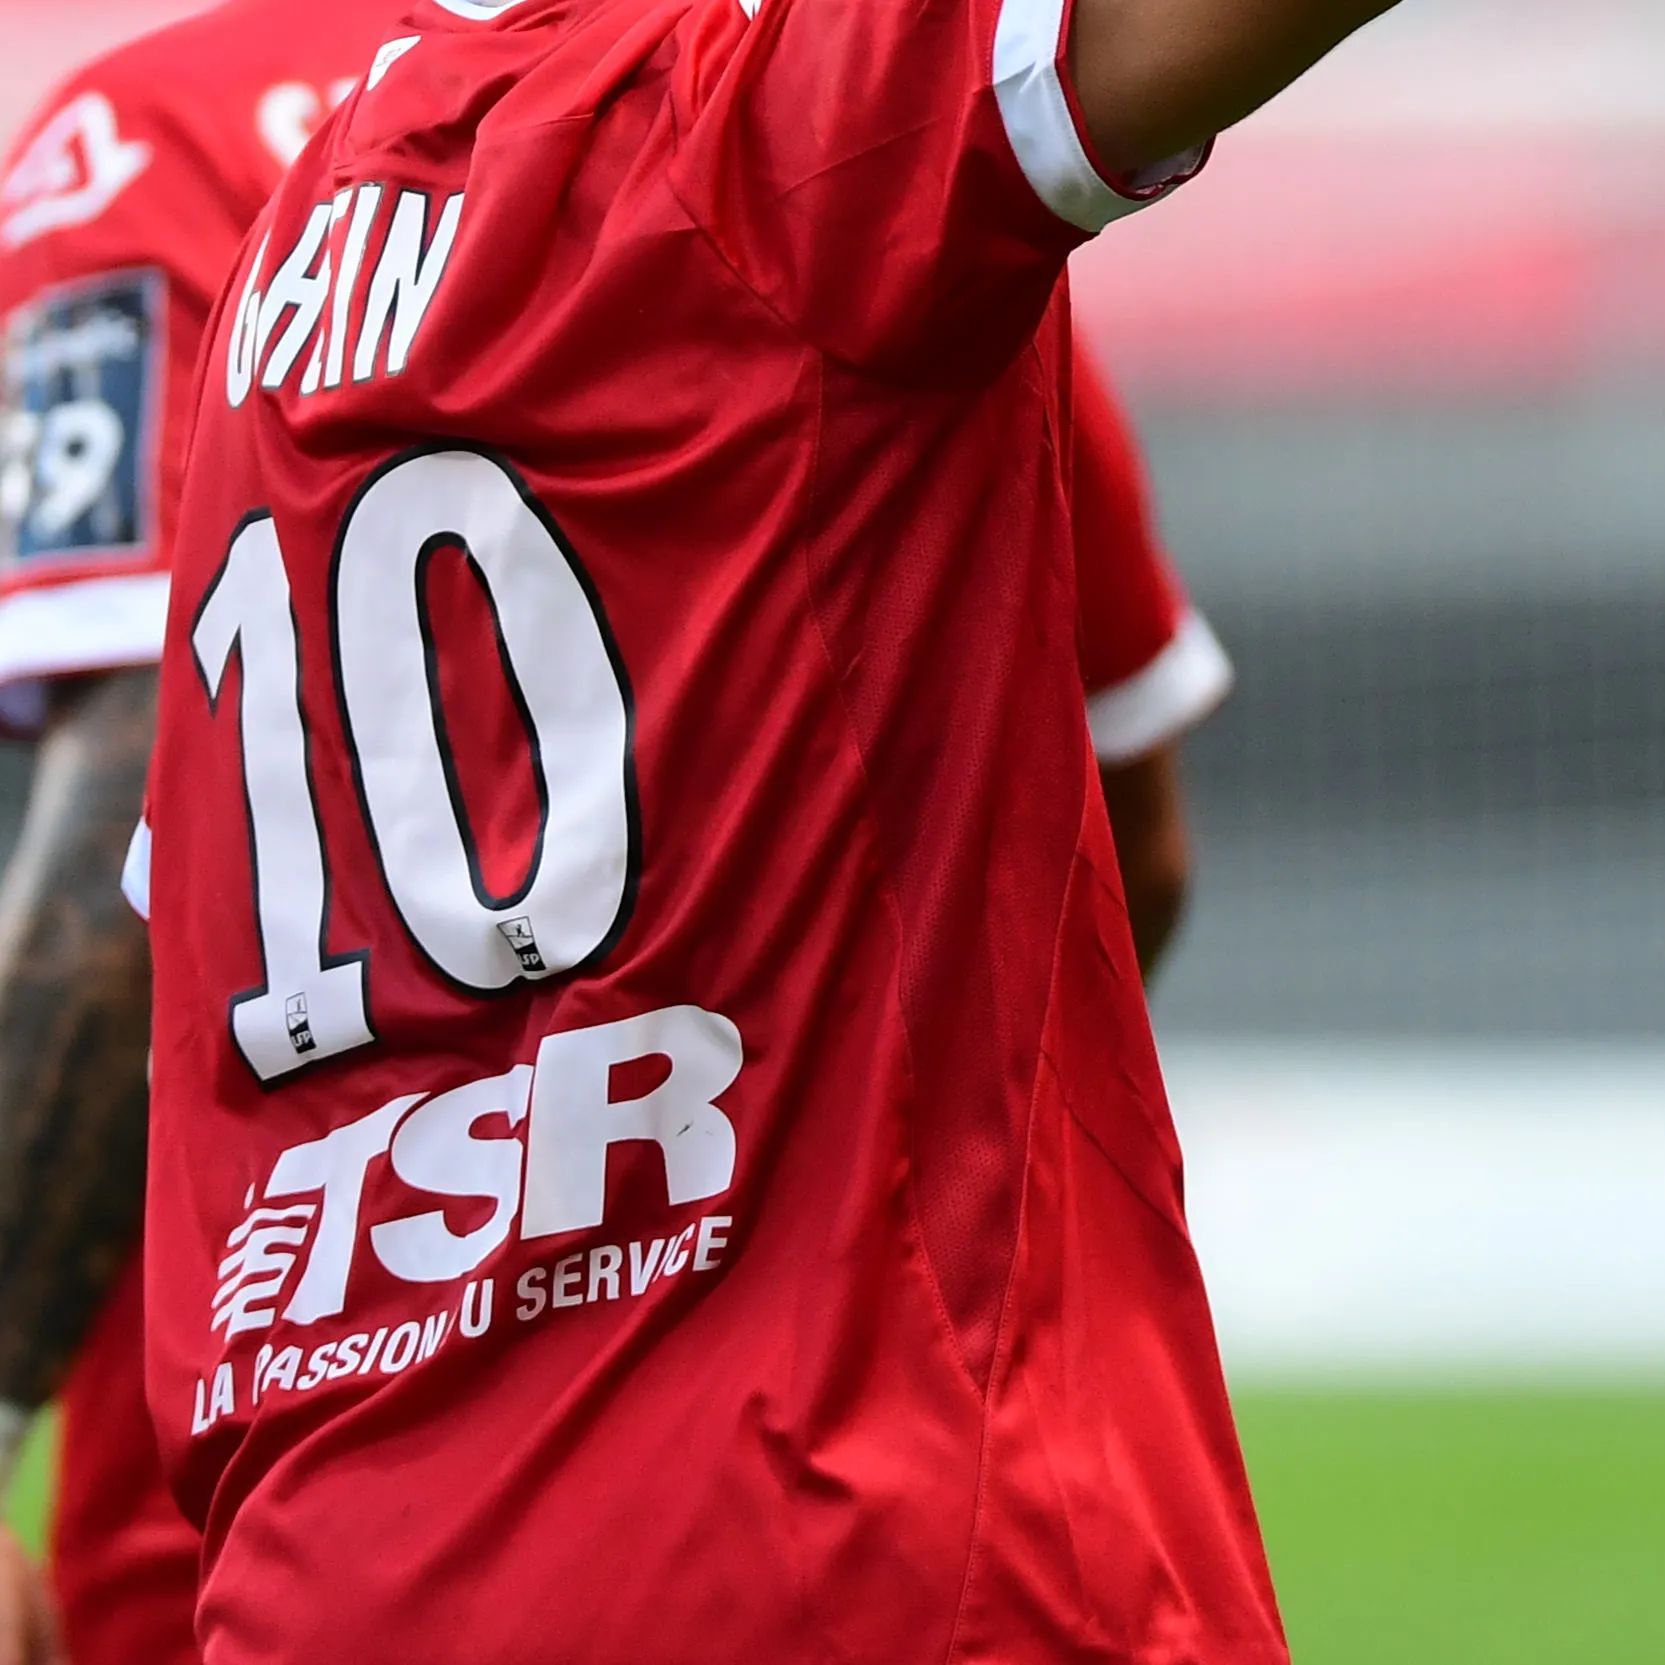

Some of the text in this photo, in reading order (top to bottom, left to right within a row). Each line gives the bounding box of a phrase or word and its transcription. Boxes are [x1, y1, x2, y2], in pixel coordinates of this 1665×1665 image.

[190, 440, 642, 1083] 10
[264, 1004, 744, 1326] TSR
[191, 1362, 235, 1436] LA
[252, 1310, 449, 1407] PASSION
